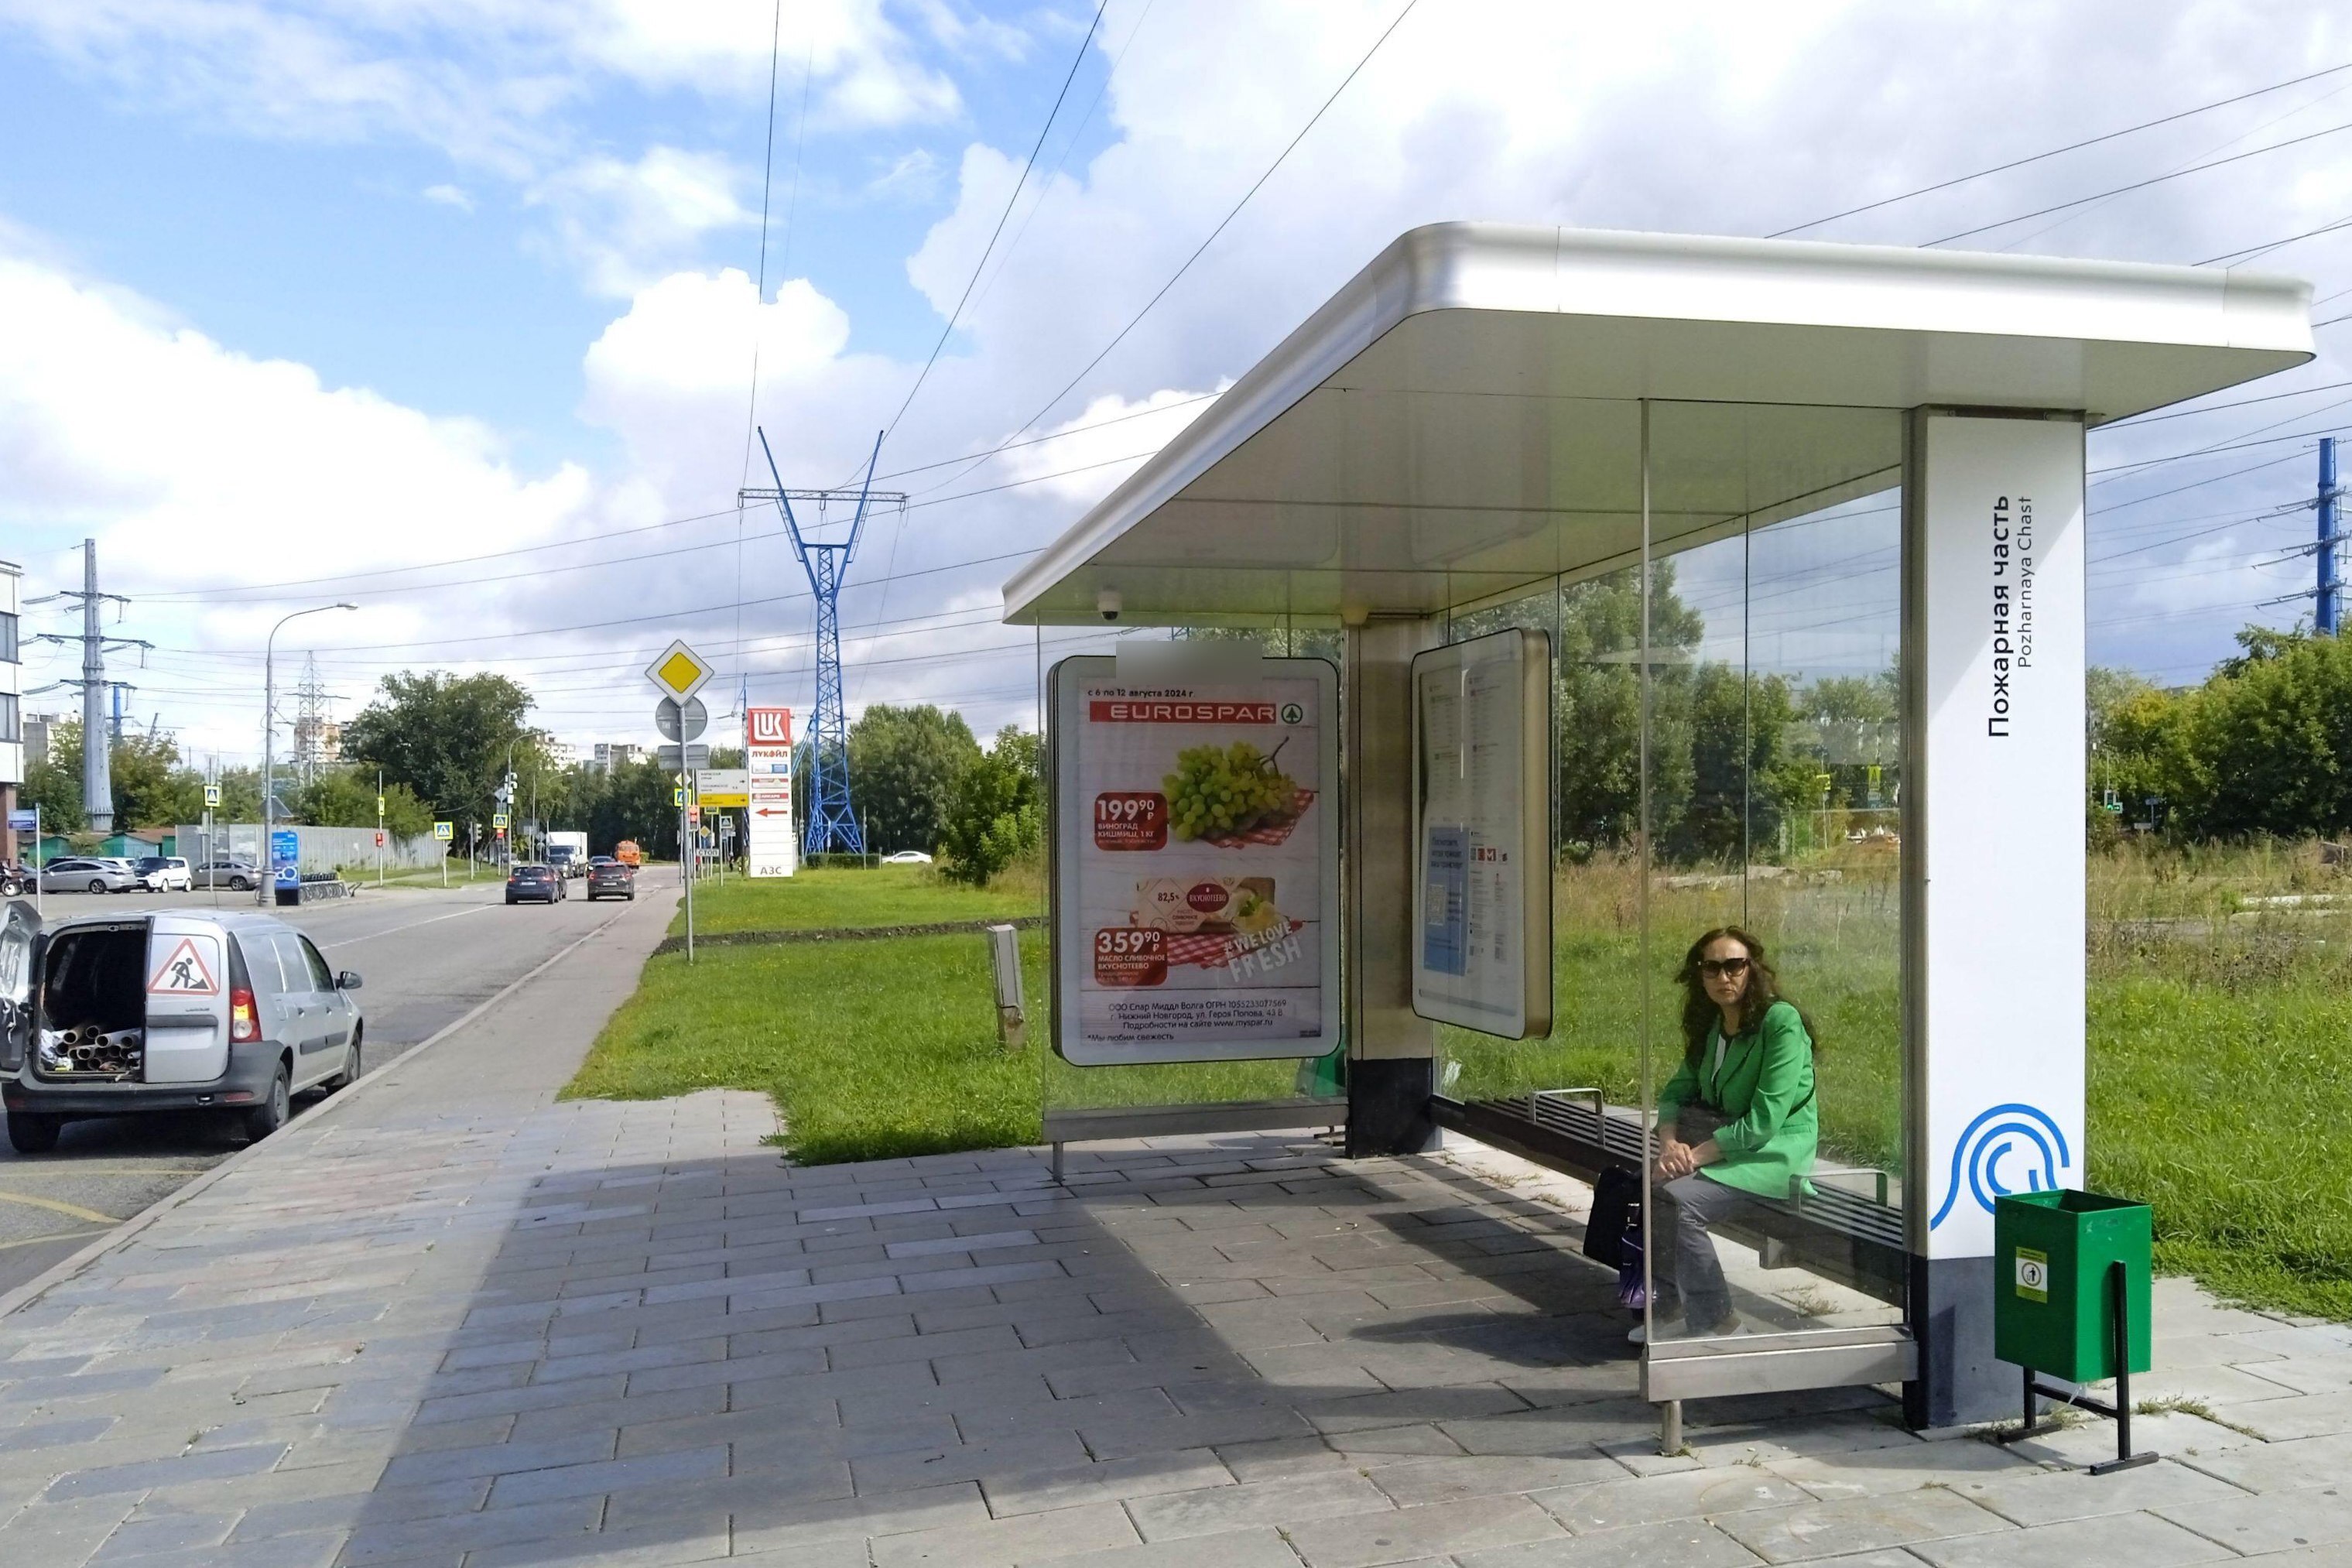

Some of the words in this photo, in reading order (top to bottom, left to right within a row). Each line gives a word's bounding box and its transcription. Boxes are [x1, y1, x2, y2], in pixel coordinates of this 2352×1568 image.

[2018, 496, 2032, 551] Chast
[1994, 496, 2009, 576] часть
[2018, 556, 2035, 668] Pozharnaya
[1988, 585, 2014, 738] Пожарная
[1128, 690, 1162, 698] августа
[1165, 689, 1186, 697] 2024
[1111, 704, 1275, 721] EUROSPAR
[760, 866, 782, 875] АЗС
[1189, 893, 1227, 902] ВКУСНОТЕЕВО
[1258, 920, 1292, 944] LOVE
[1130, 1003, 1150, 1012] Спар
[1152, 1002, 1179, 1011] Миддл
[1181, 1001, 1203, 1010] Волга
[1209, 1010, 1231, 1019] Героя
[1123, 1022, 1176, 1030] Подробности
[1214, 1019, 1273, 1028] www.myspar.ru
